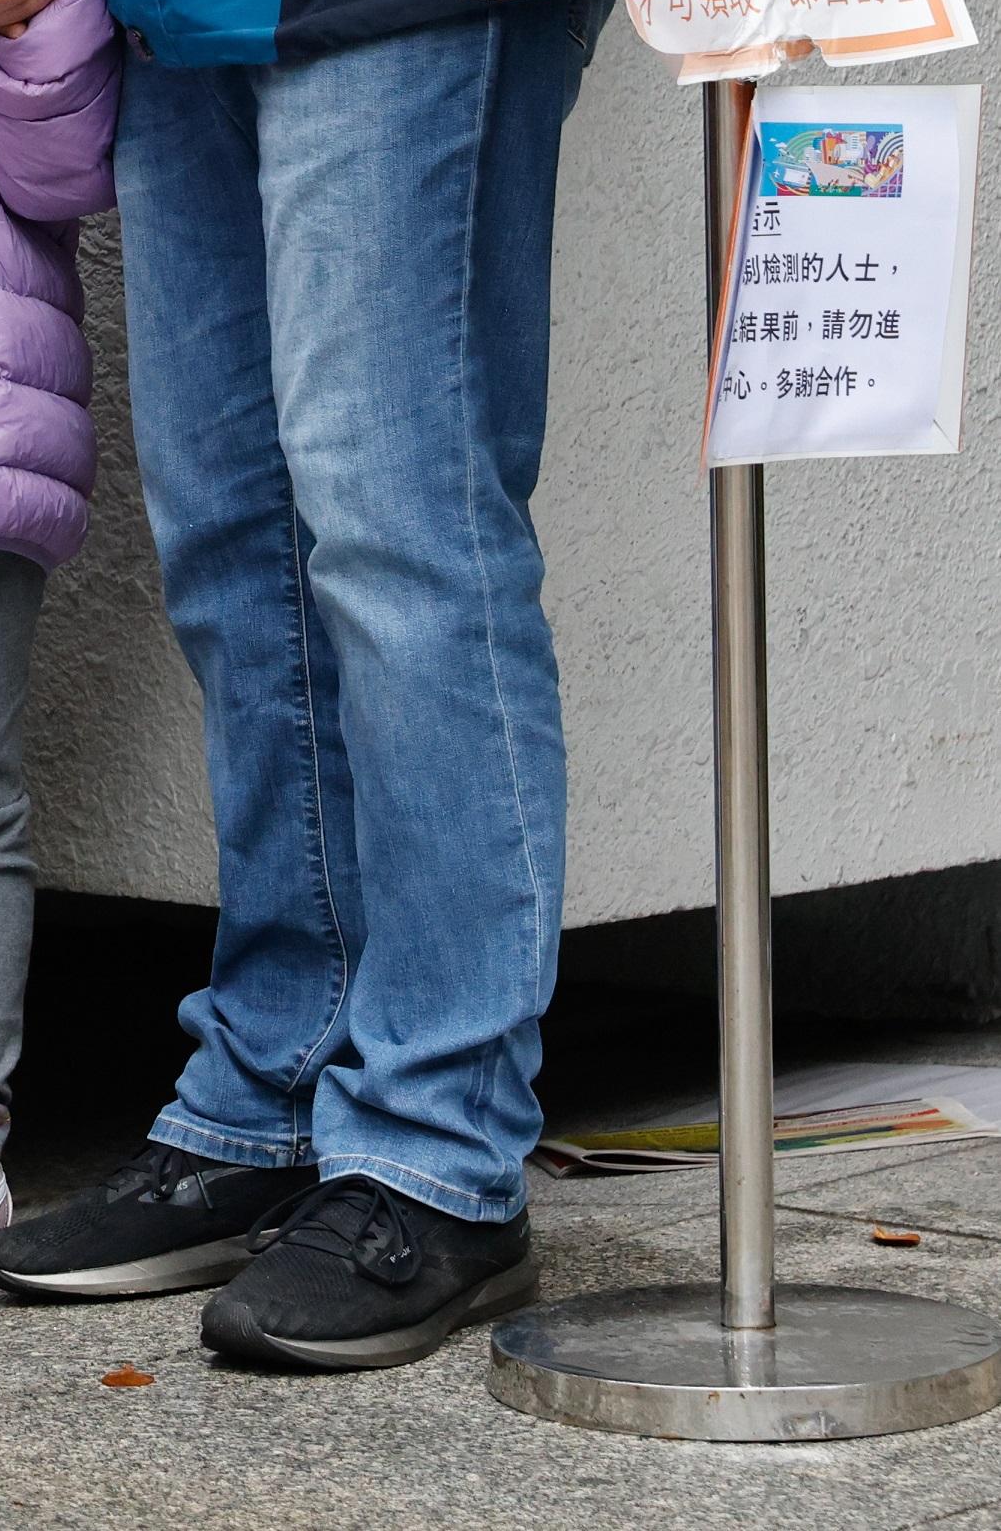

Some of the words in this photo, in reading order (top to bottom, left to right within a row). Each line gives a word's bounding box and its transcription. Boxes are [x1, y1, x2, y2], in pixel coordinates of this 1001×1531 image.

[731, 309, 900, 344] 結果前，請勿進
[718, 366, 876, 403] 中心。多謝合作。
